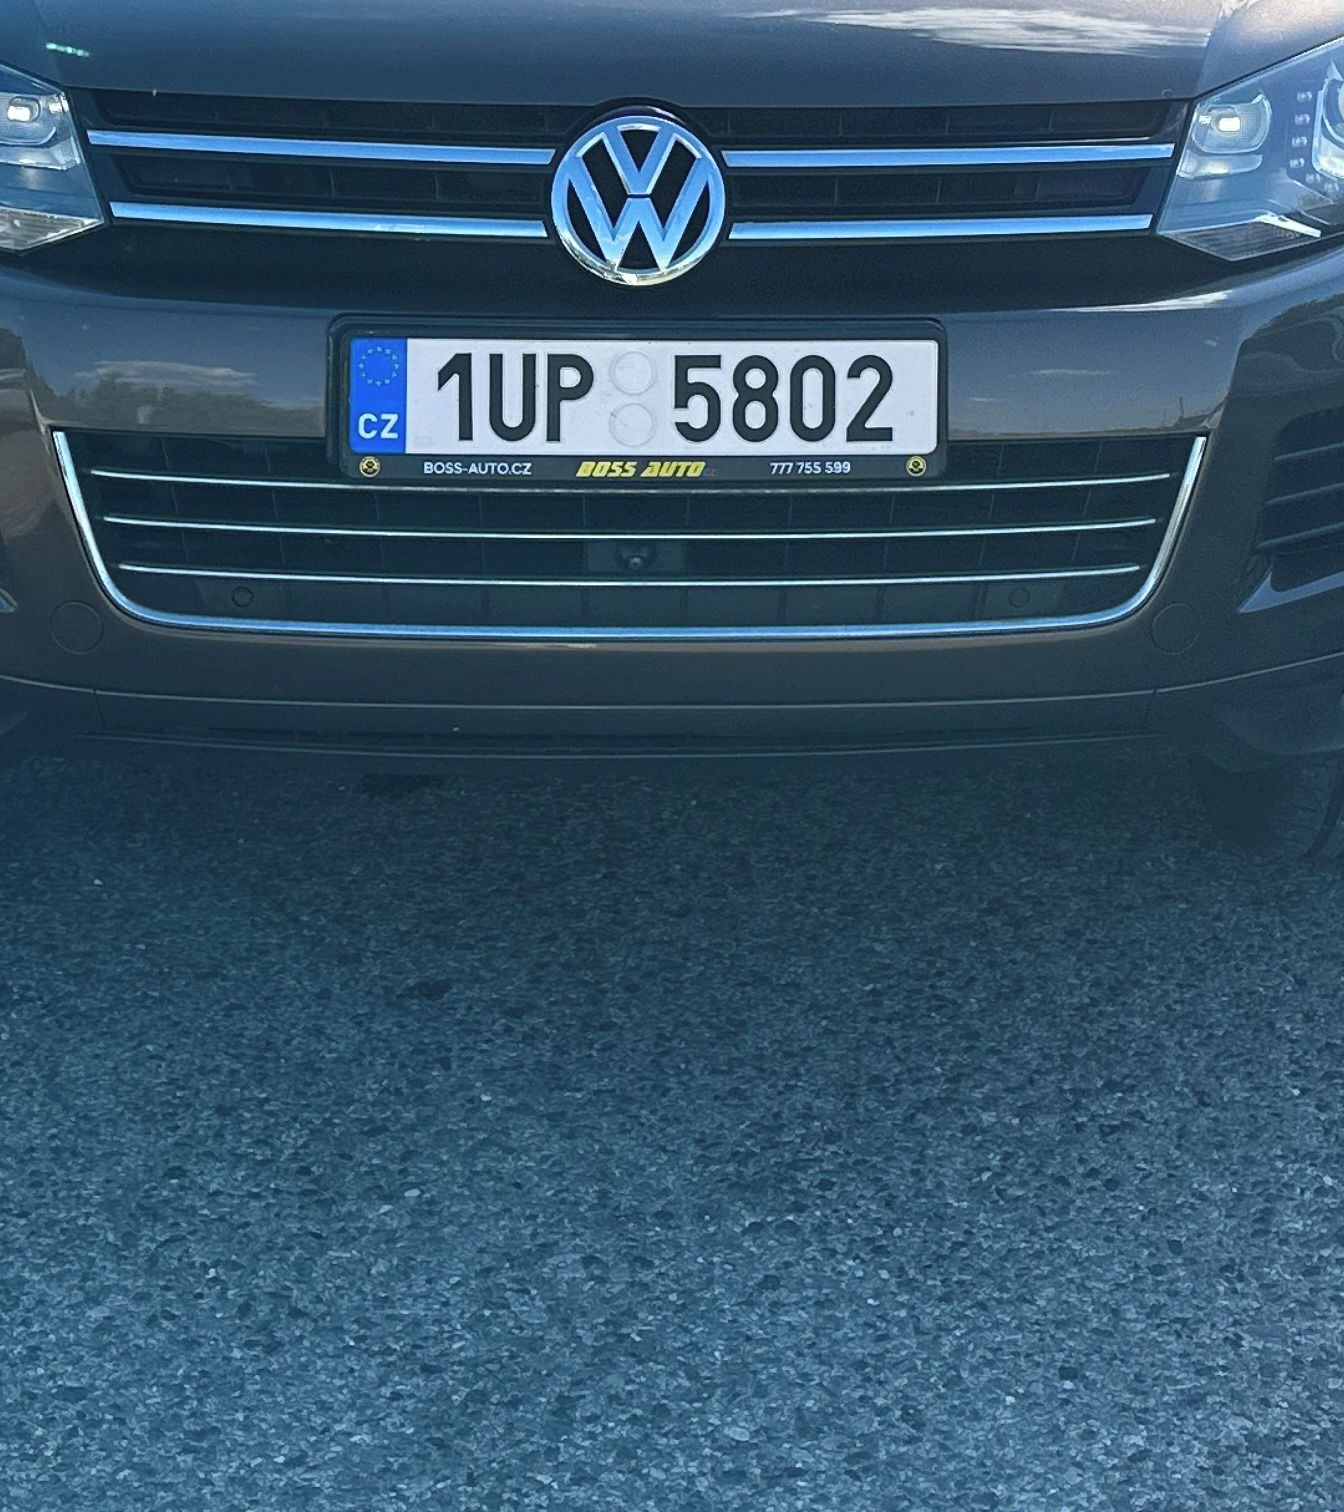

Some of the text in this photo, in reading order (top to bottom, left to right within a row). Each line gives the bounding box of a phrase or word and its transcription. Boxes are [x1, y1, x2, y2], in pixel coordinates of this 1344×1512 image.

[437, 352, 895, 444] 1UP 5802
[358, 413, 399, 439] CZ
[423, 461, 533, 476] BOSS-AUTO.CZ
[575, 461, 638, 478] BOSS
[640, 461, 706, 478] AUTO
[770, 461, 851, 475] 777 755 599
